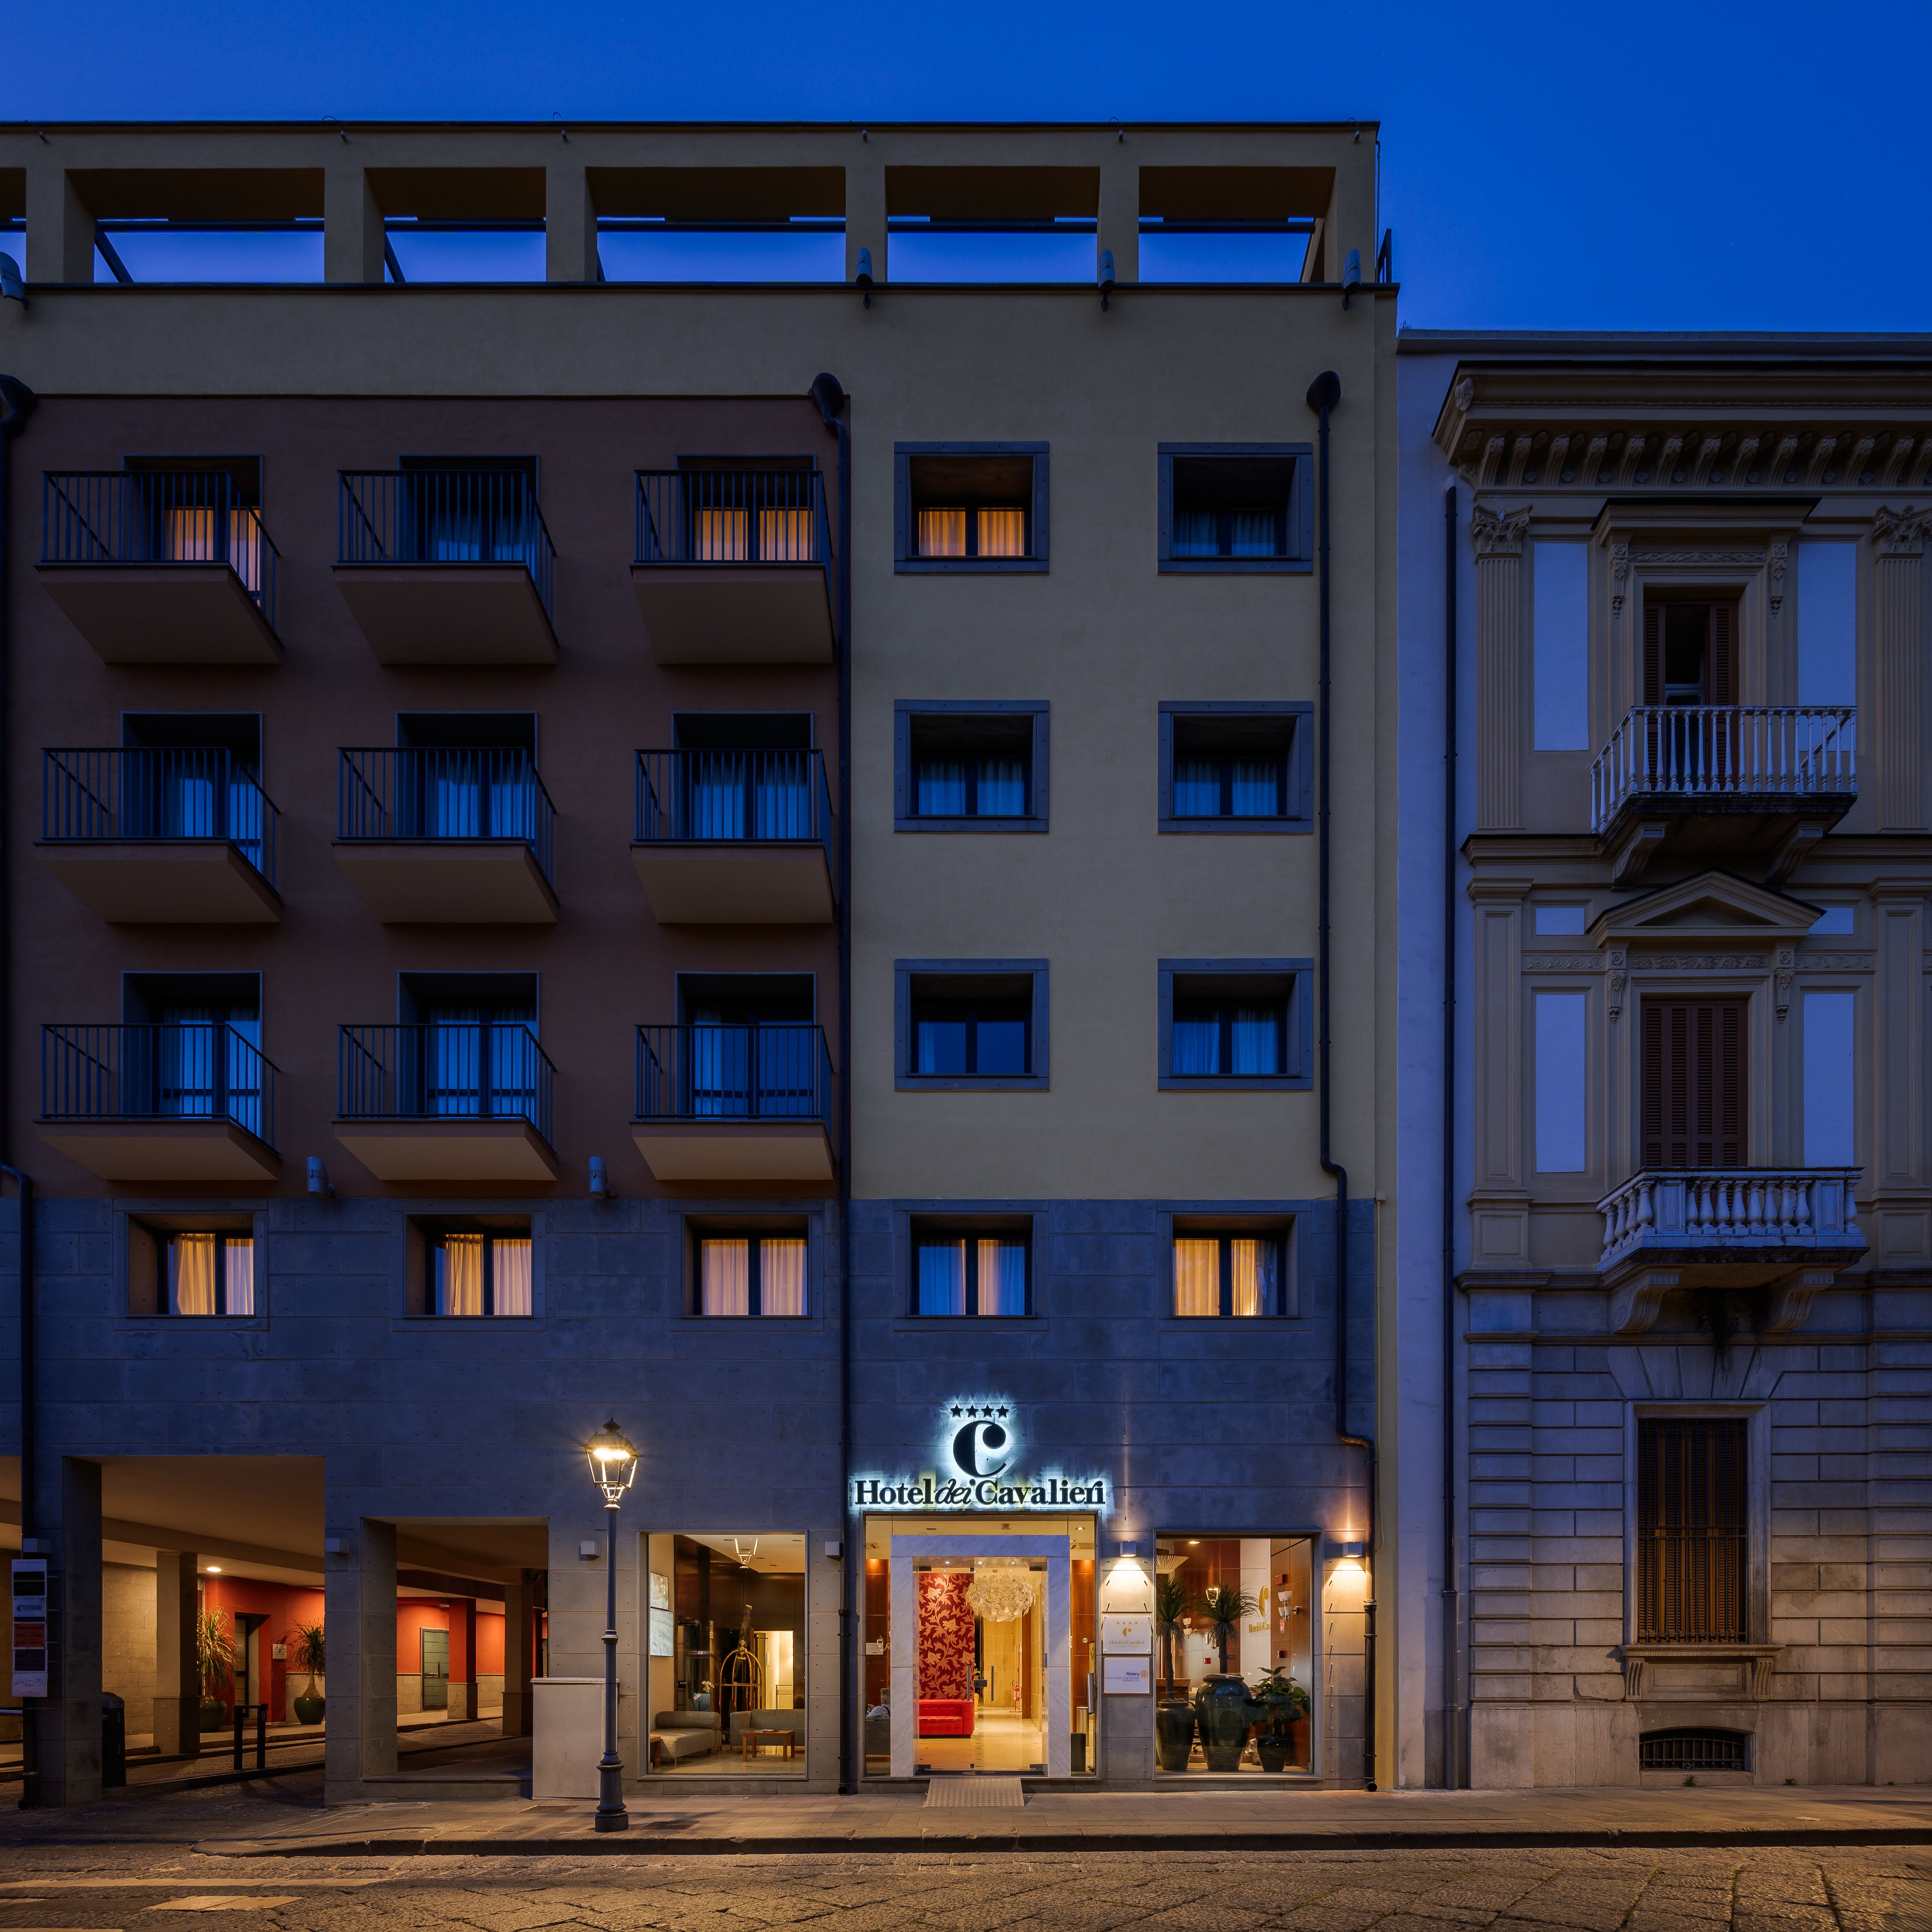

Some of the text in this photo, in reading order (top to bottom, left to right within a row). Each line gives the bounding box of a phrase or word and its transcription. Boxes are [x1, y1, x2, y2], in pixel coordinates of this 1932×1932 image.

[855, 1478, 933, 1505] Hotel
[975, 1479, 1106, 1505] Cavalieri
[1249, 1622, 1258, 1633] Hotel
[13, 1676, 35, 1685] Legami
